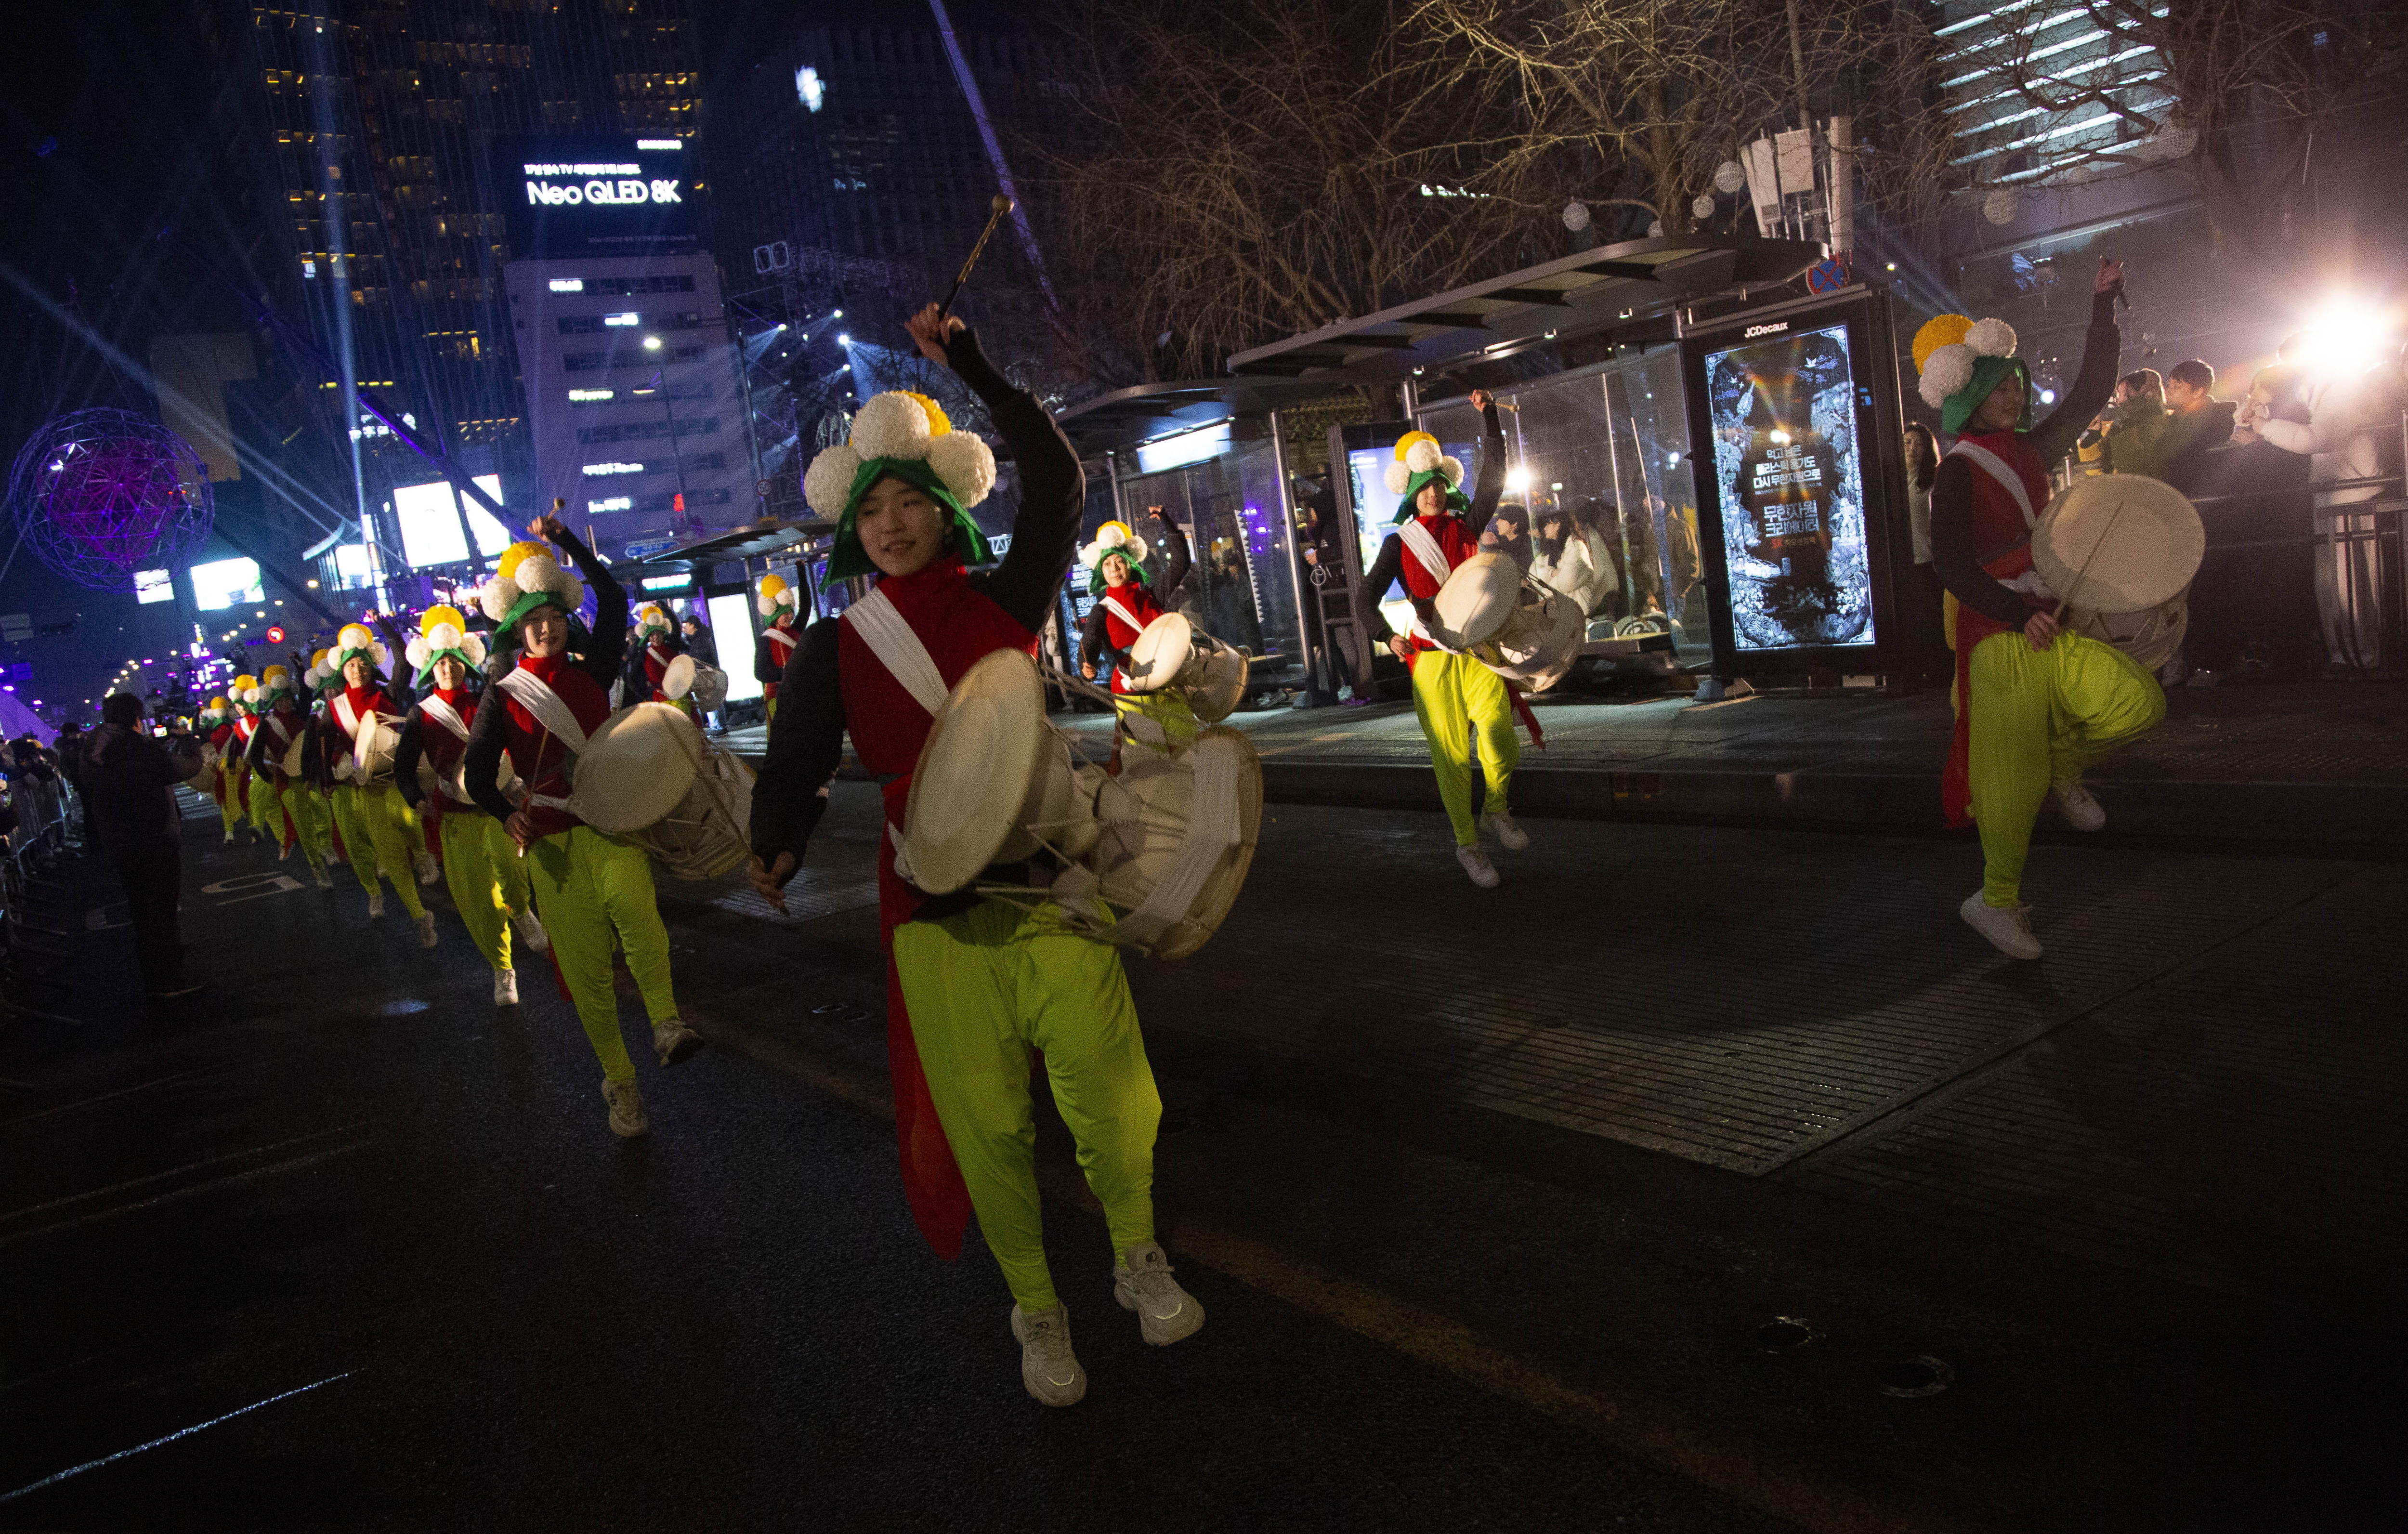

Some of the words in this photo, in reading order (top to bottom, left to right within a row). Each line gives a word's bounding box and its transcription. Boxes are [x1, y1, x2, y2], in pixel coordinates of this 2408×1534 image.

[559, 164, 574, 174] TV
[526, 181, 583, 205] Neo
[585, 180, 649, 204] QLED
[651, 179, 682, 203] 8K
[1744, 322, 1788, 338] JCDecaux
[1753, 476, 1771, 488] 다시
[1764, 499, 1818, 523] 무한자원
